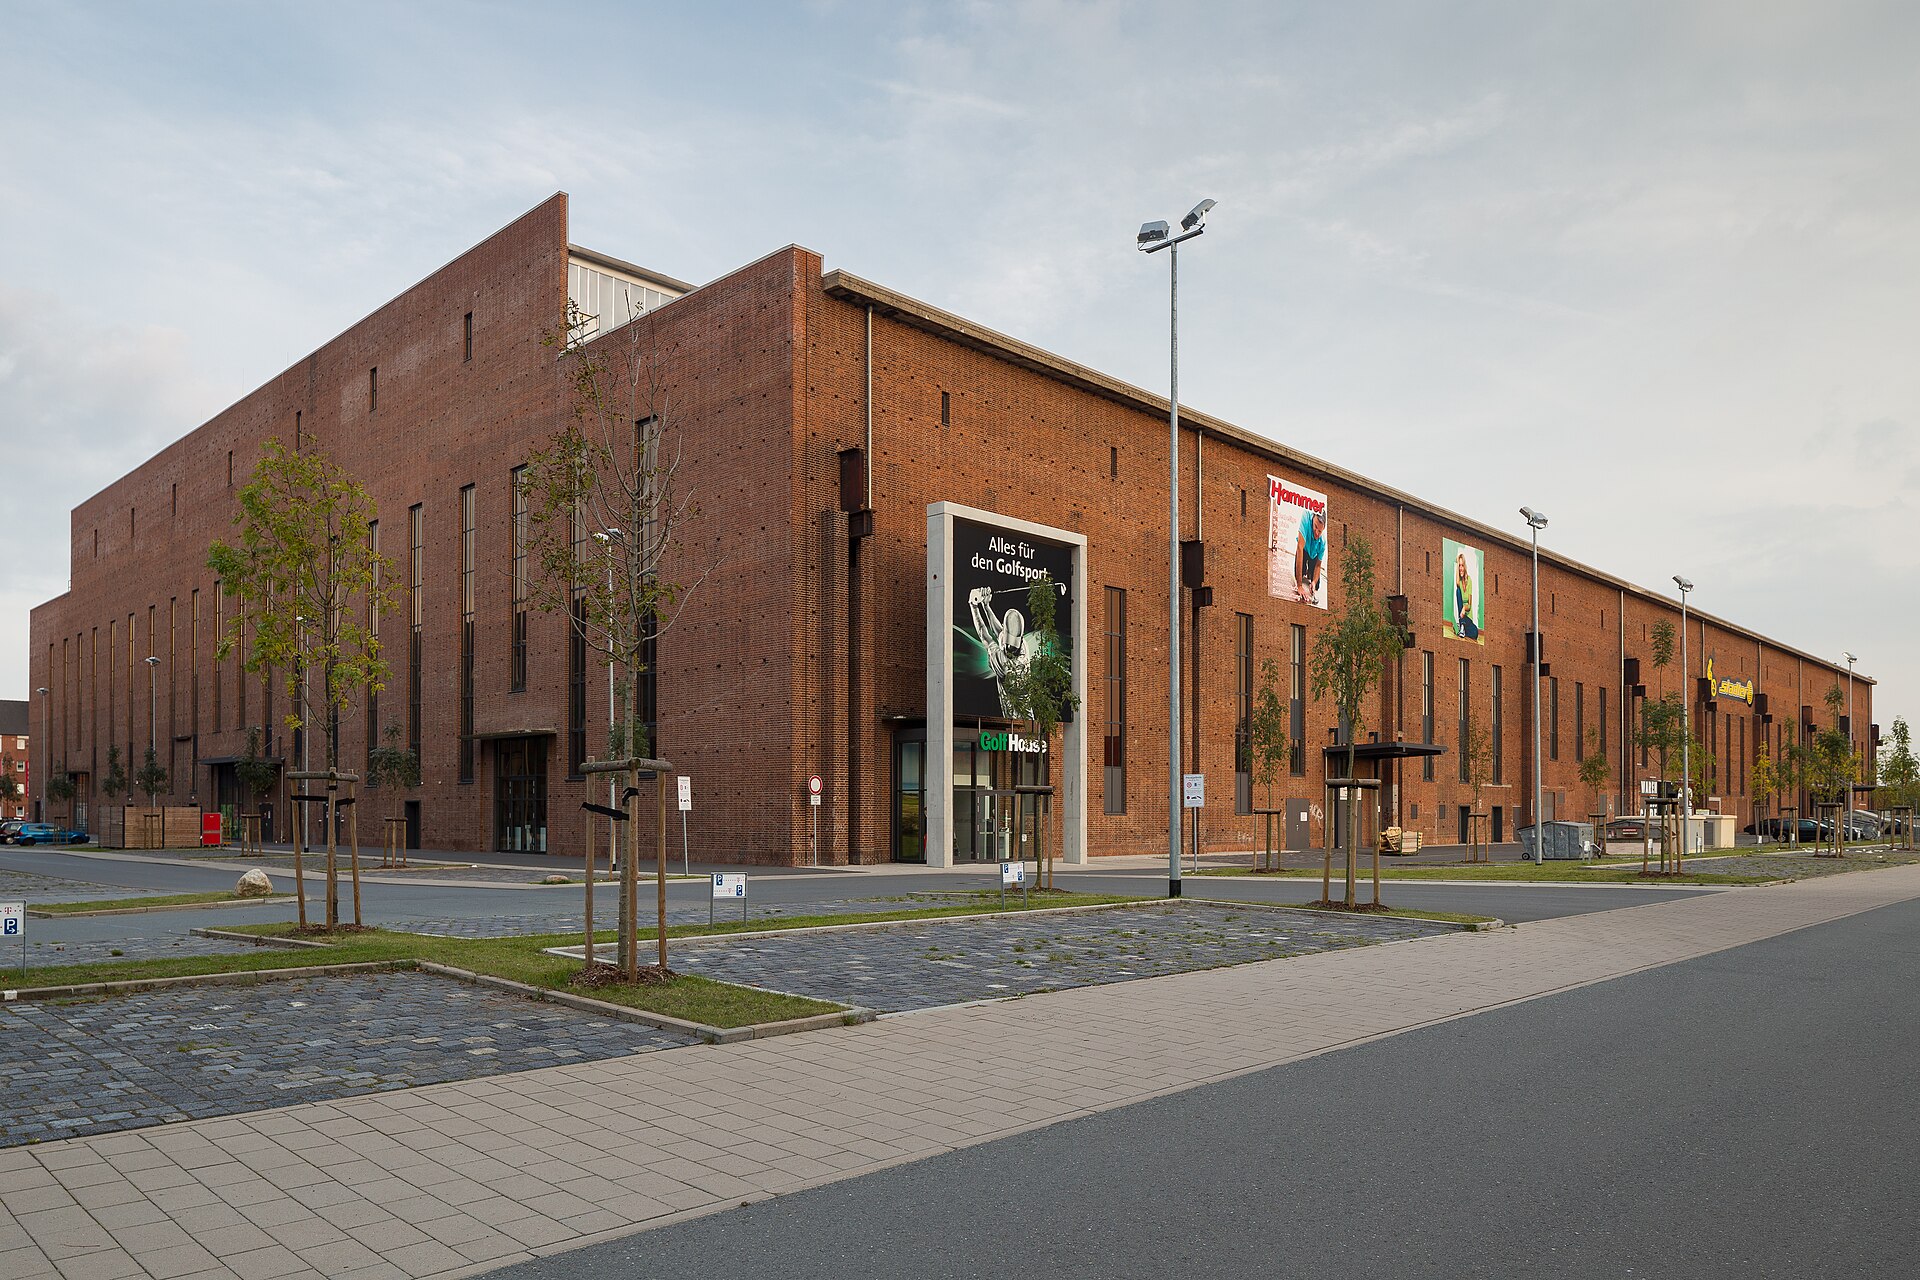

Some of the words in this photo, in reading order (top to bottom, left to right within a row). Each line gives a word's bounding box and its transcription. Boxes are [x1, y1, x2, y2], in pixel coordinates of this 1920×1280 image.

[1271, 479, 1325, 515] Hammer
[988, 536, 1016, 556] Alles
[1018, 541, 1036, 560] für
[971, 552, 994, 571] den
[996, 558, 1048, 583] Golfsport
[6, 919, 16, 931] P
